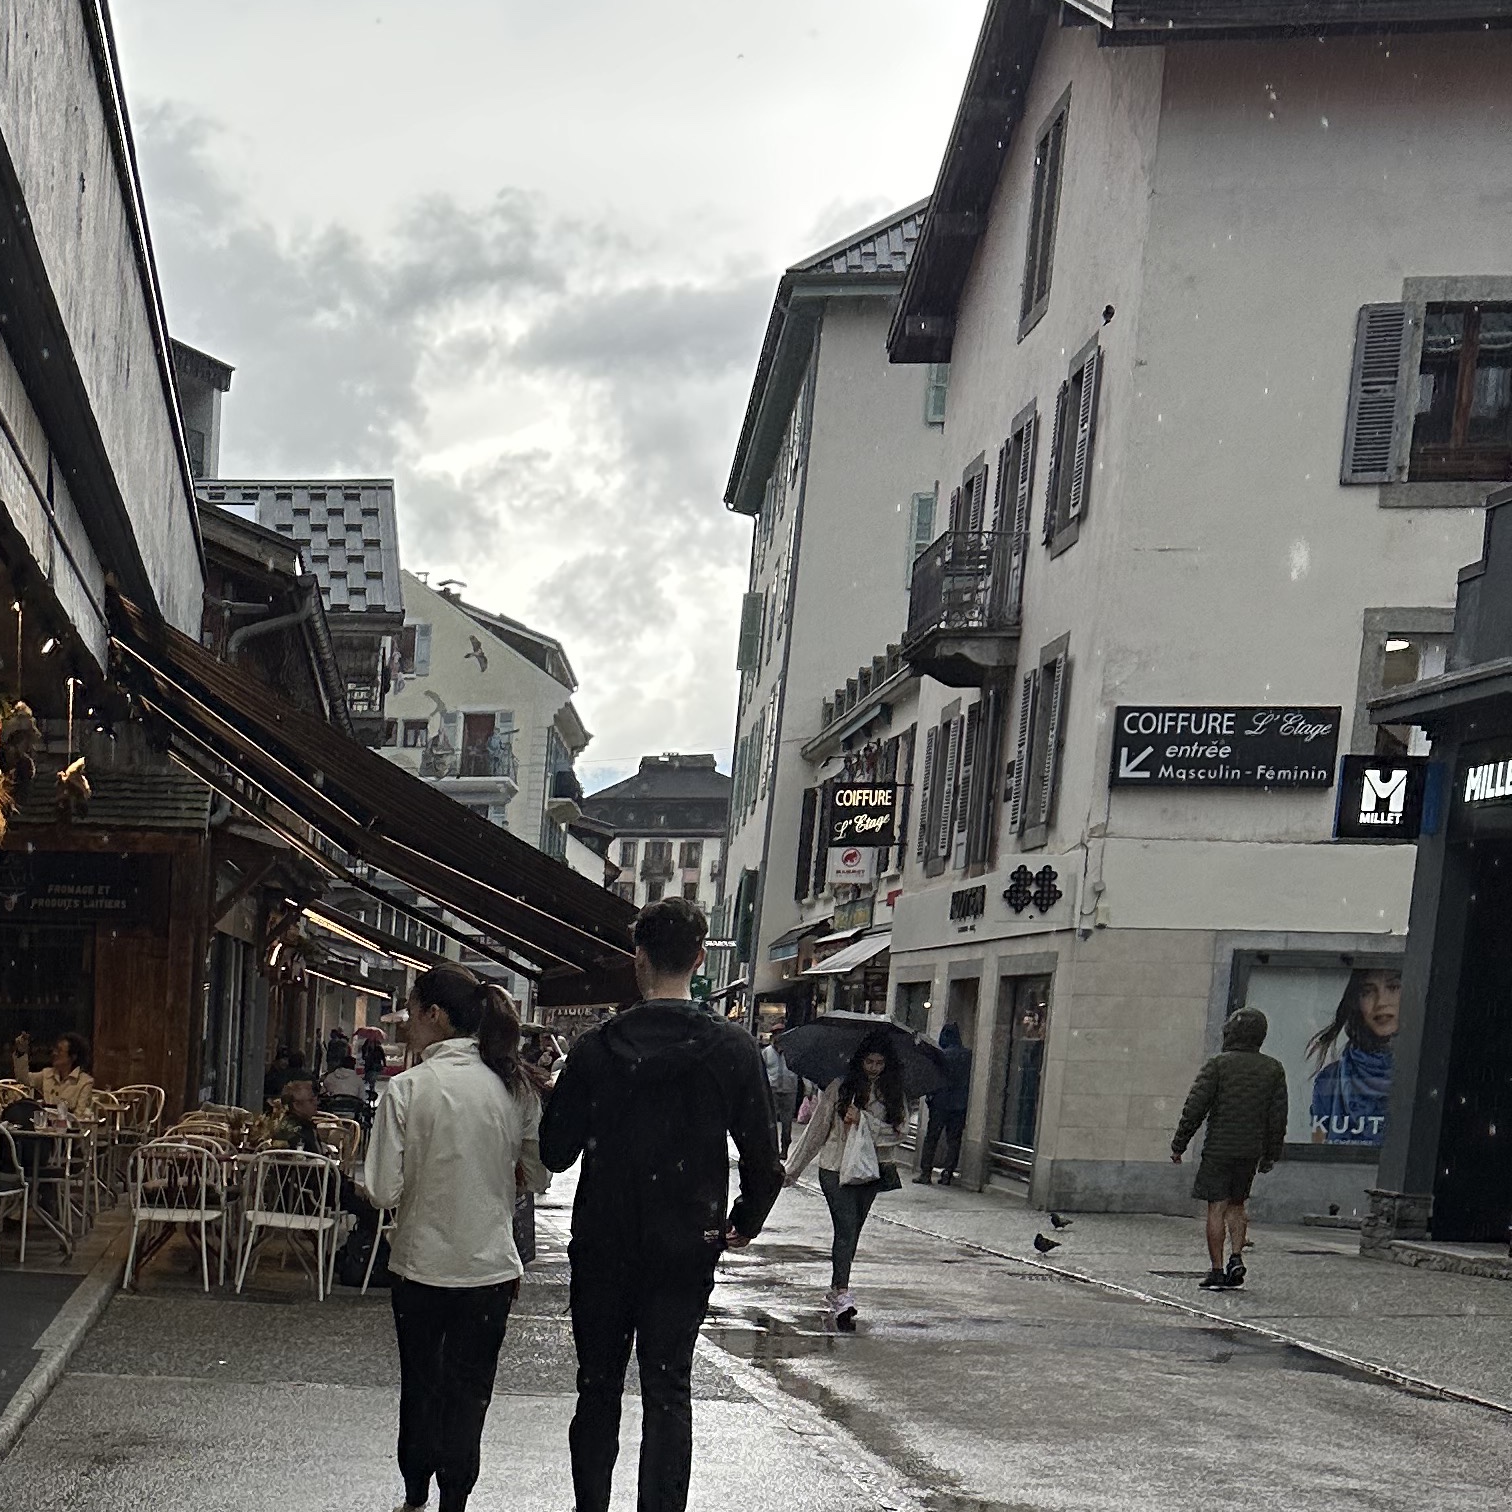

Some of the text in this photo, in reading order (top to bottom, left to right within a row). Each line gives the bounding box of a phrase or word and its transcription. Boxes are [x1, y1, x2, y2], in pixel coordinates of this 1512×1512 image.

[1123, 712, 1236, 735] COIFFURE
[1165, 741, 1232, 759] entrée
[1157, 765, 1241, 781] Masculin
[1255, 764, 1328, 781] Féminin
[835, 789, 893, 807] COIFFURE
[1359, 812, 1403, 825] MILLET
[47, 885, 111, 895] FROMAGE ET
[31, 898, 127, 909] PRODUITS LAITIERS
